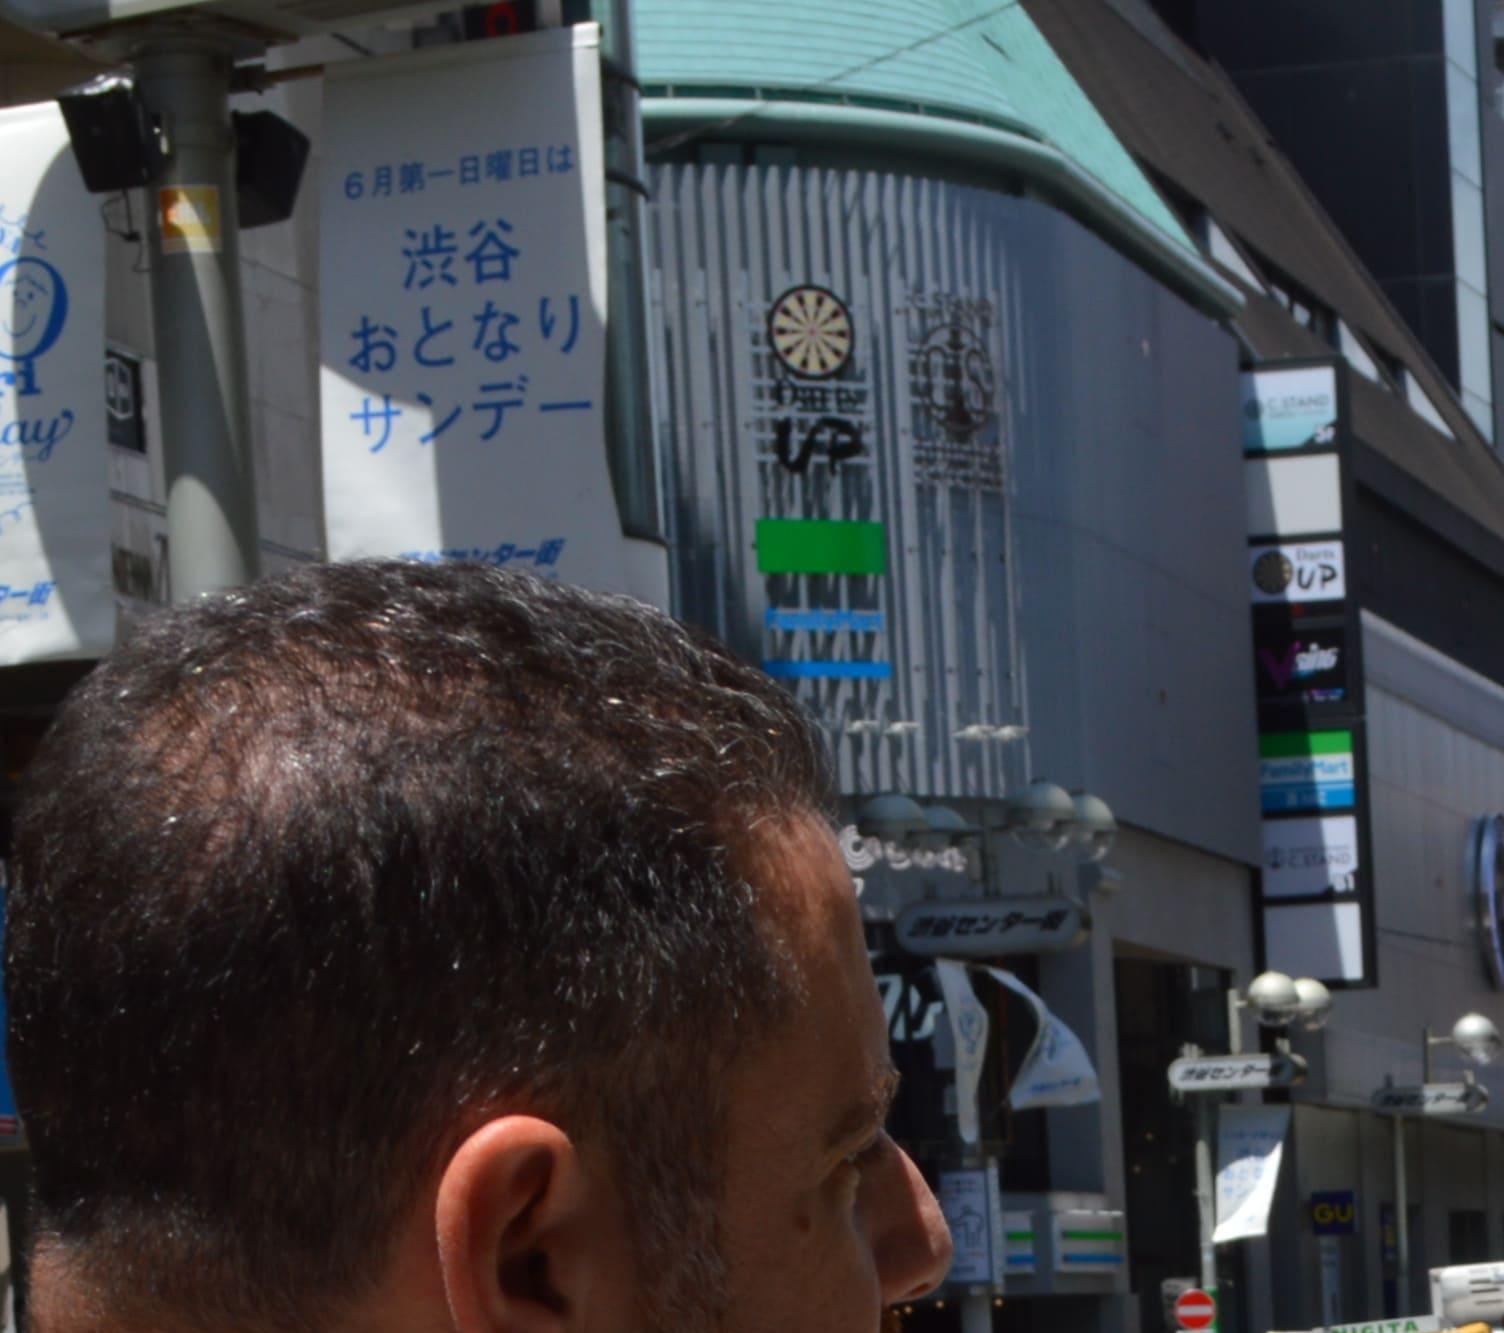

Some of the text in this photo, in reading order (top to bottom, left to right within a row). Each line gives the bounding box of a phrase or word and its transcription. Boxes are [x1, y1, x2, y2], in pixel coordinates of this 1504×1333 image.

[344, 145, 575, 198] 6月第一日曜日は
[402, 218, 520, 288] 渋谷
[349, 295, 580, 374] おとなり
[349, 375, 593, 453] サンデー
[1297, 564, 1338, 591] UP
[1313, 1203, 1353, 1224] GU
